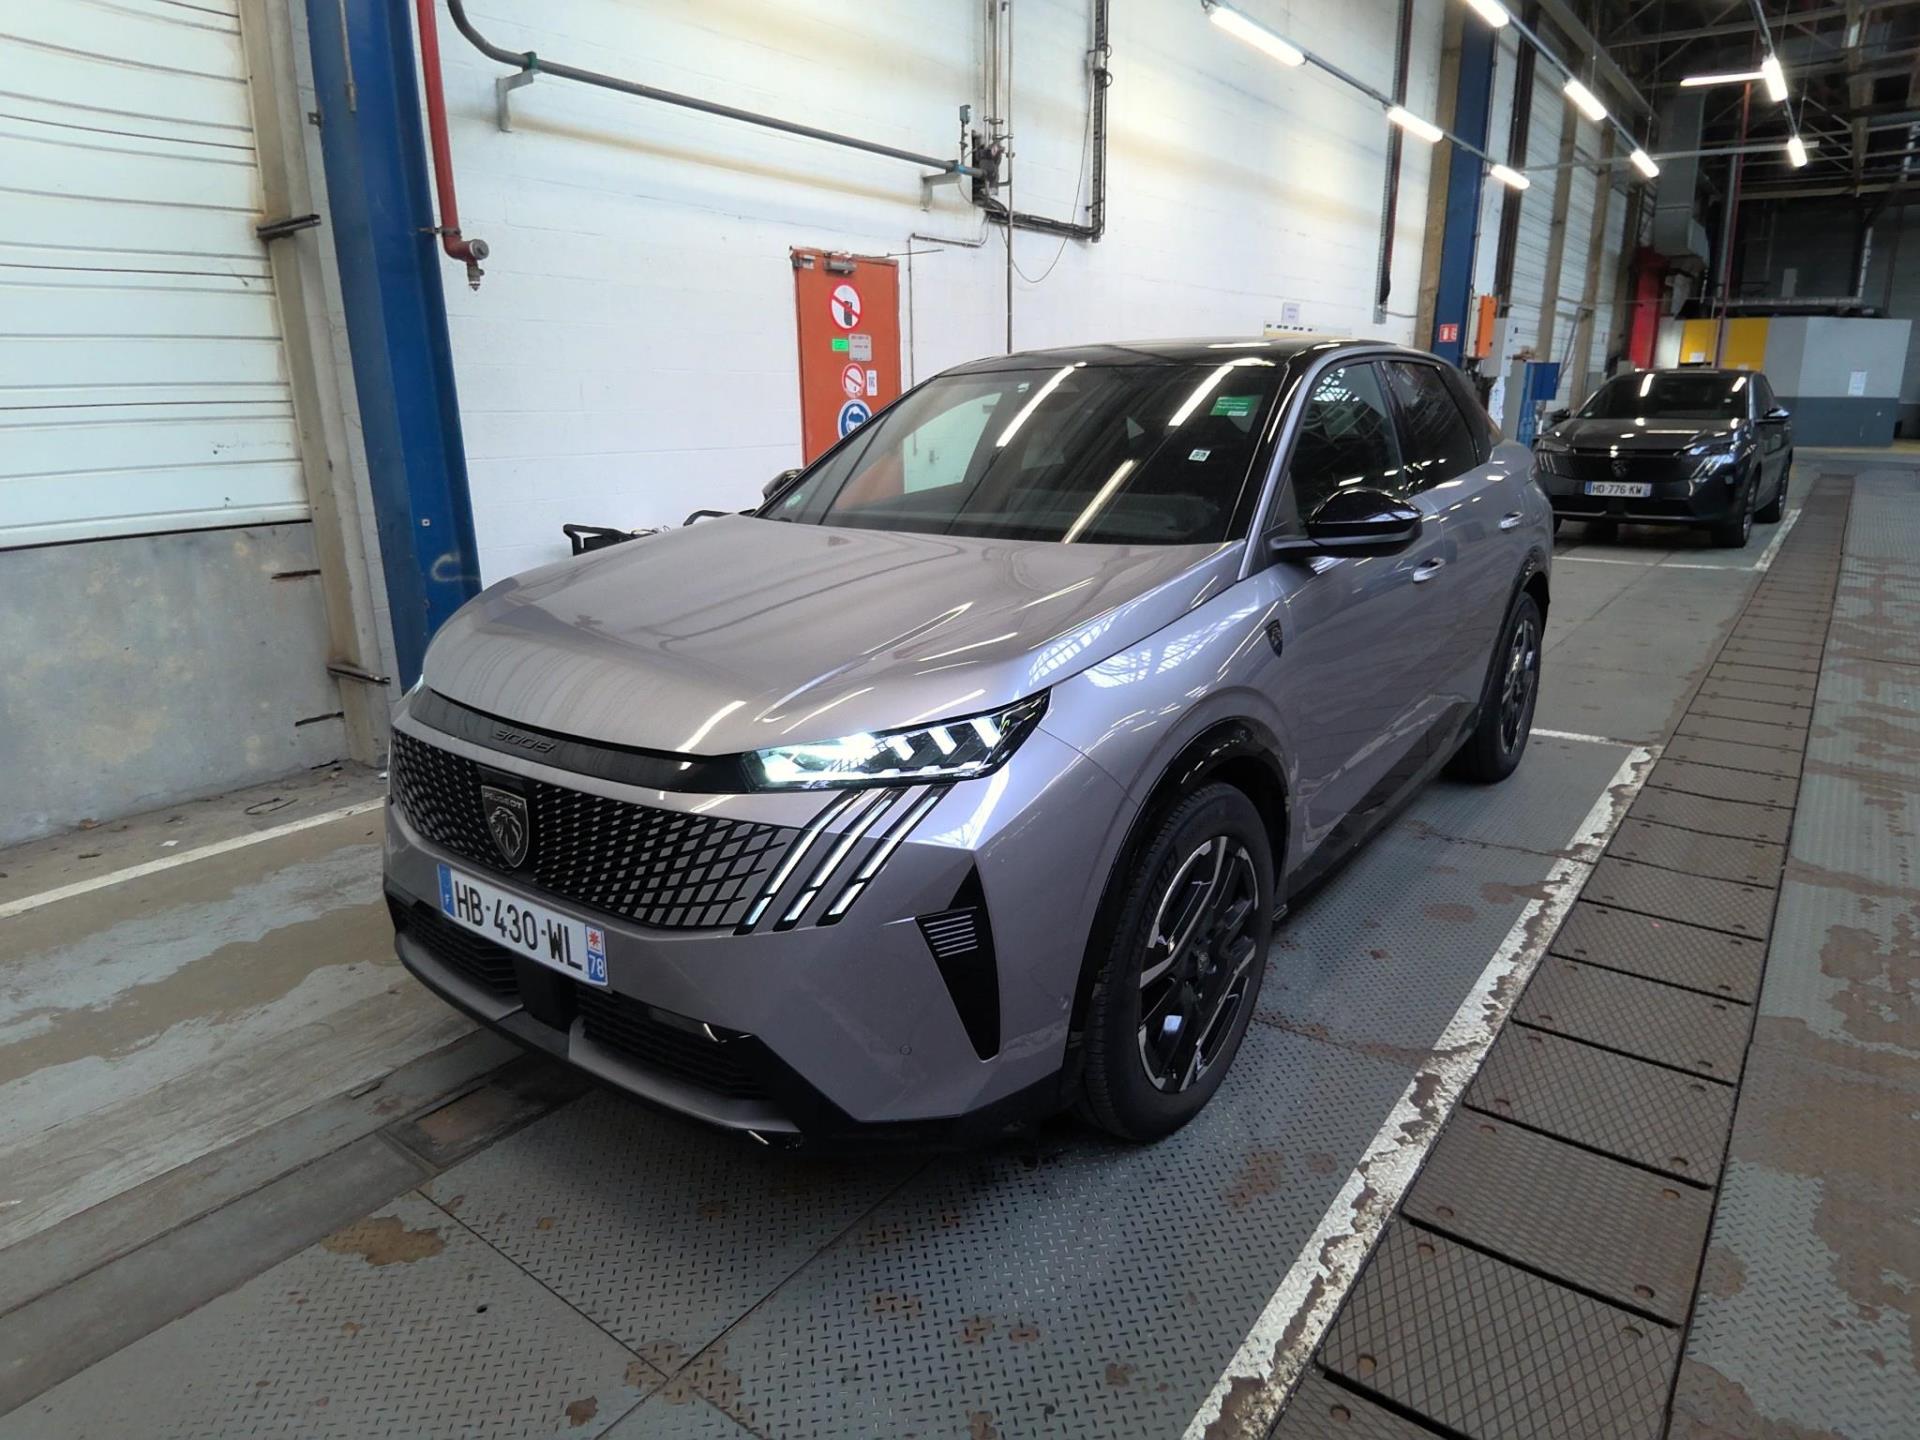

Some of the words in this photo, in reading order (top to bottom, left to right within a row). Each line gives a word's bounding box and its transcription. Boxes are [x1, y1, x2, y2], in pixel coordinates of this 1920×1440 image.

[491, 730, 557, 753] 3008
[455, 881, 583, 971] HB-430-WL
[588, 954, 605, 978] 78
